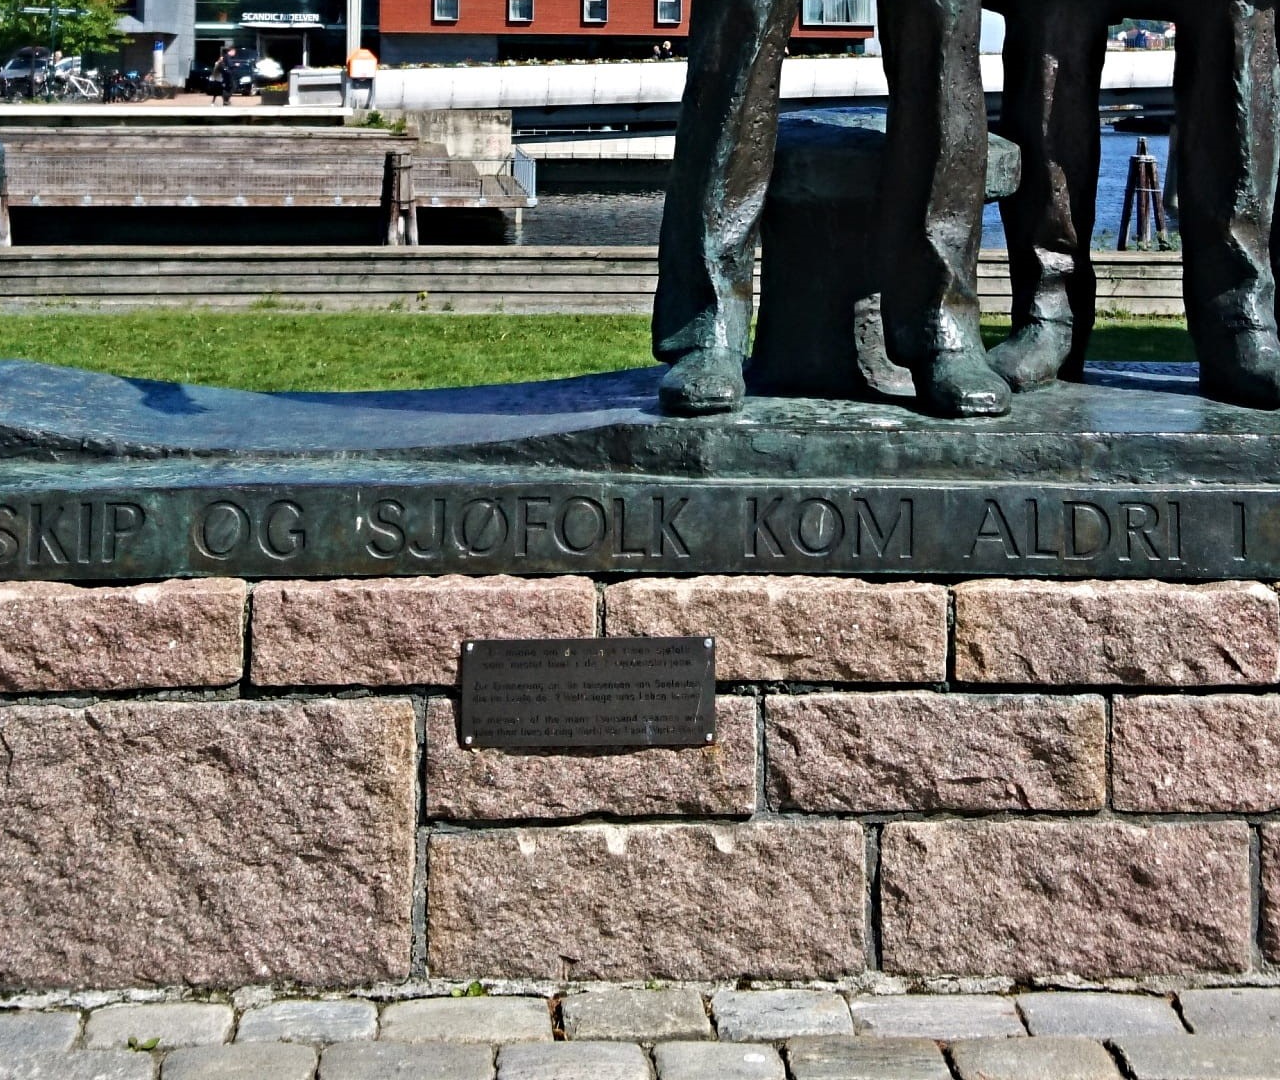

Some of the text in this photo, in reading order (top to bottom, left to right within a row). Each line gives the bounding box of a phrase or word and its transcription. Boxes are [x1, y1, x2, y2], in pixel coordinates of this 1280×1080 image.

[242, 12, 320, 22] SCANDIC NIDELVEN
[192, 499, 306, 561] OG
[365, 495, 690, 559] SJØFOLK
[744, 497, 914, 558] KOM
[963, 498, 1182, 562] ALDRI
[1232, 501, 1247, 562] I
